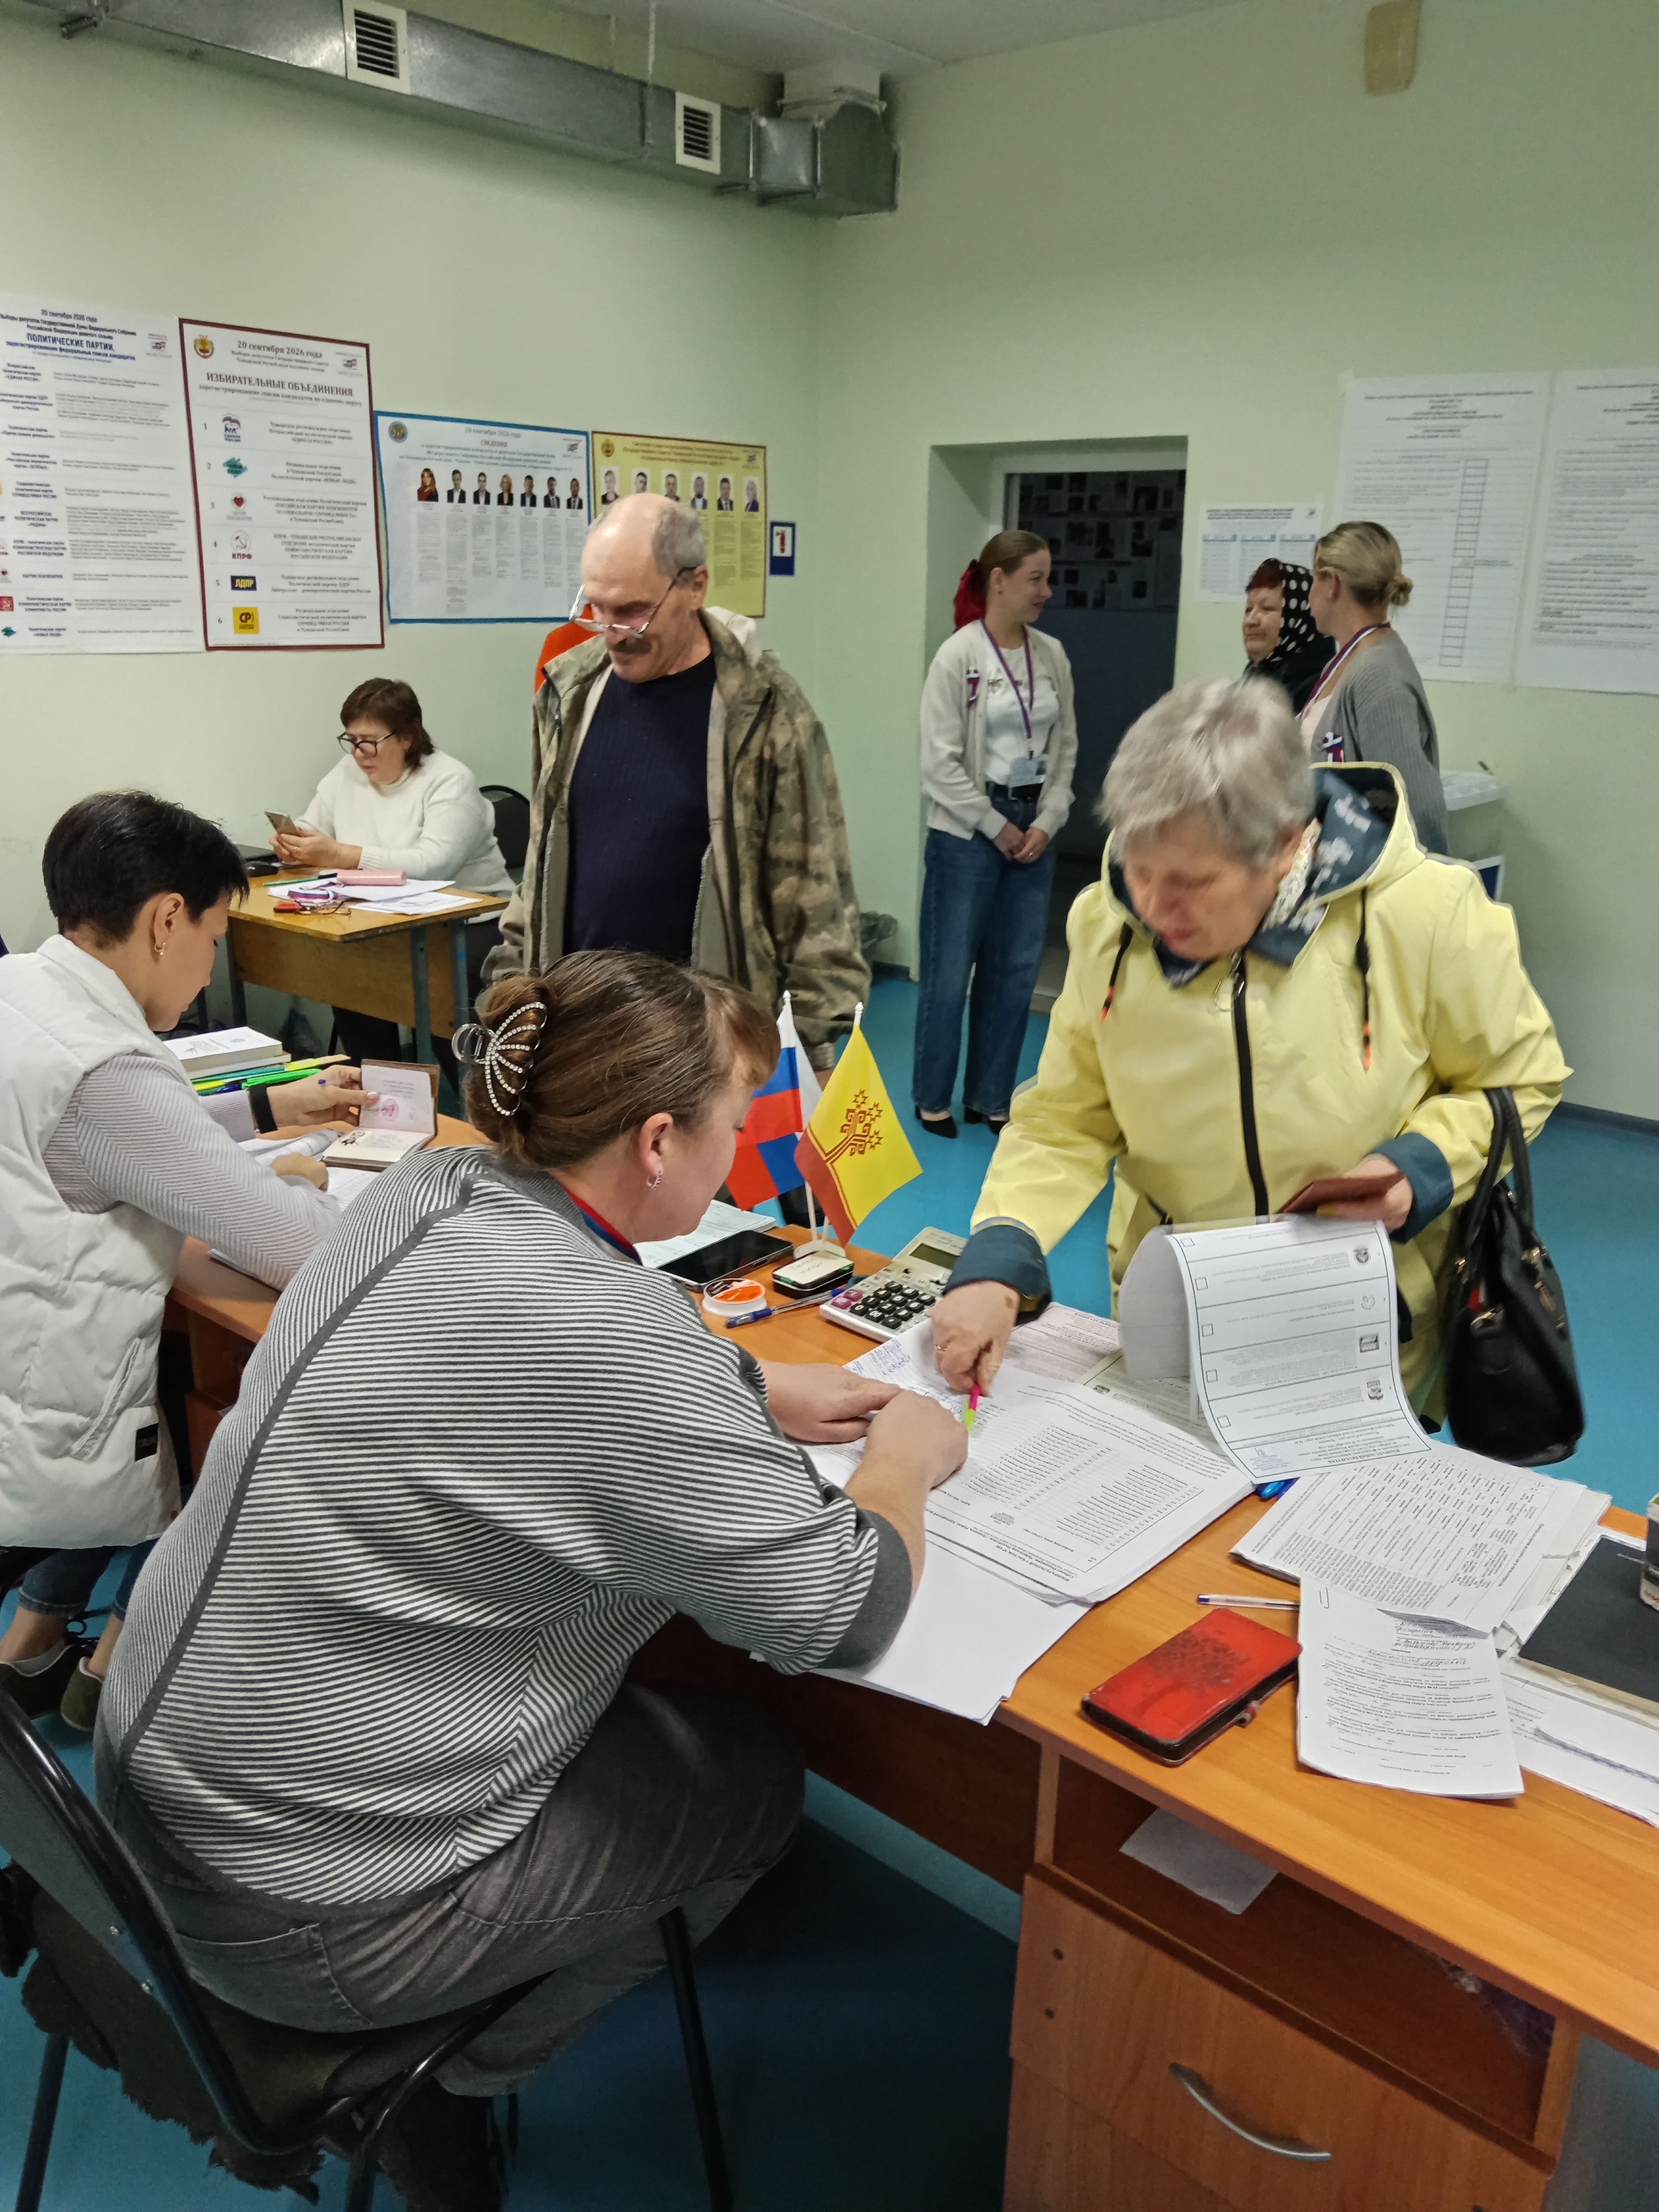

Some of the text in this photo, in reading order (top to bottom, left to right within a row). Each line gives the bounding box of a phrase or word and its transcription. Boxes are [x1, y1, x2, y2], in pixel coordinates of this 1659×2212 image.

[27, 333, 83, 348] ПОЛИТИЧЕСКИЕ
[238, 340, 247, 348] 20
[286, 347, 304, 356] 2026
[207, 372, 352, 396] ИЗБИРАТЕЛЬНЫЕ ОБЪЕДИНЕНИЯ
[776, 530, 785, 554] 1
[234, 579, 254, 588] ЛДПР
